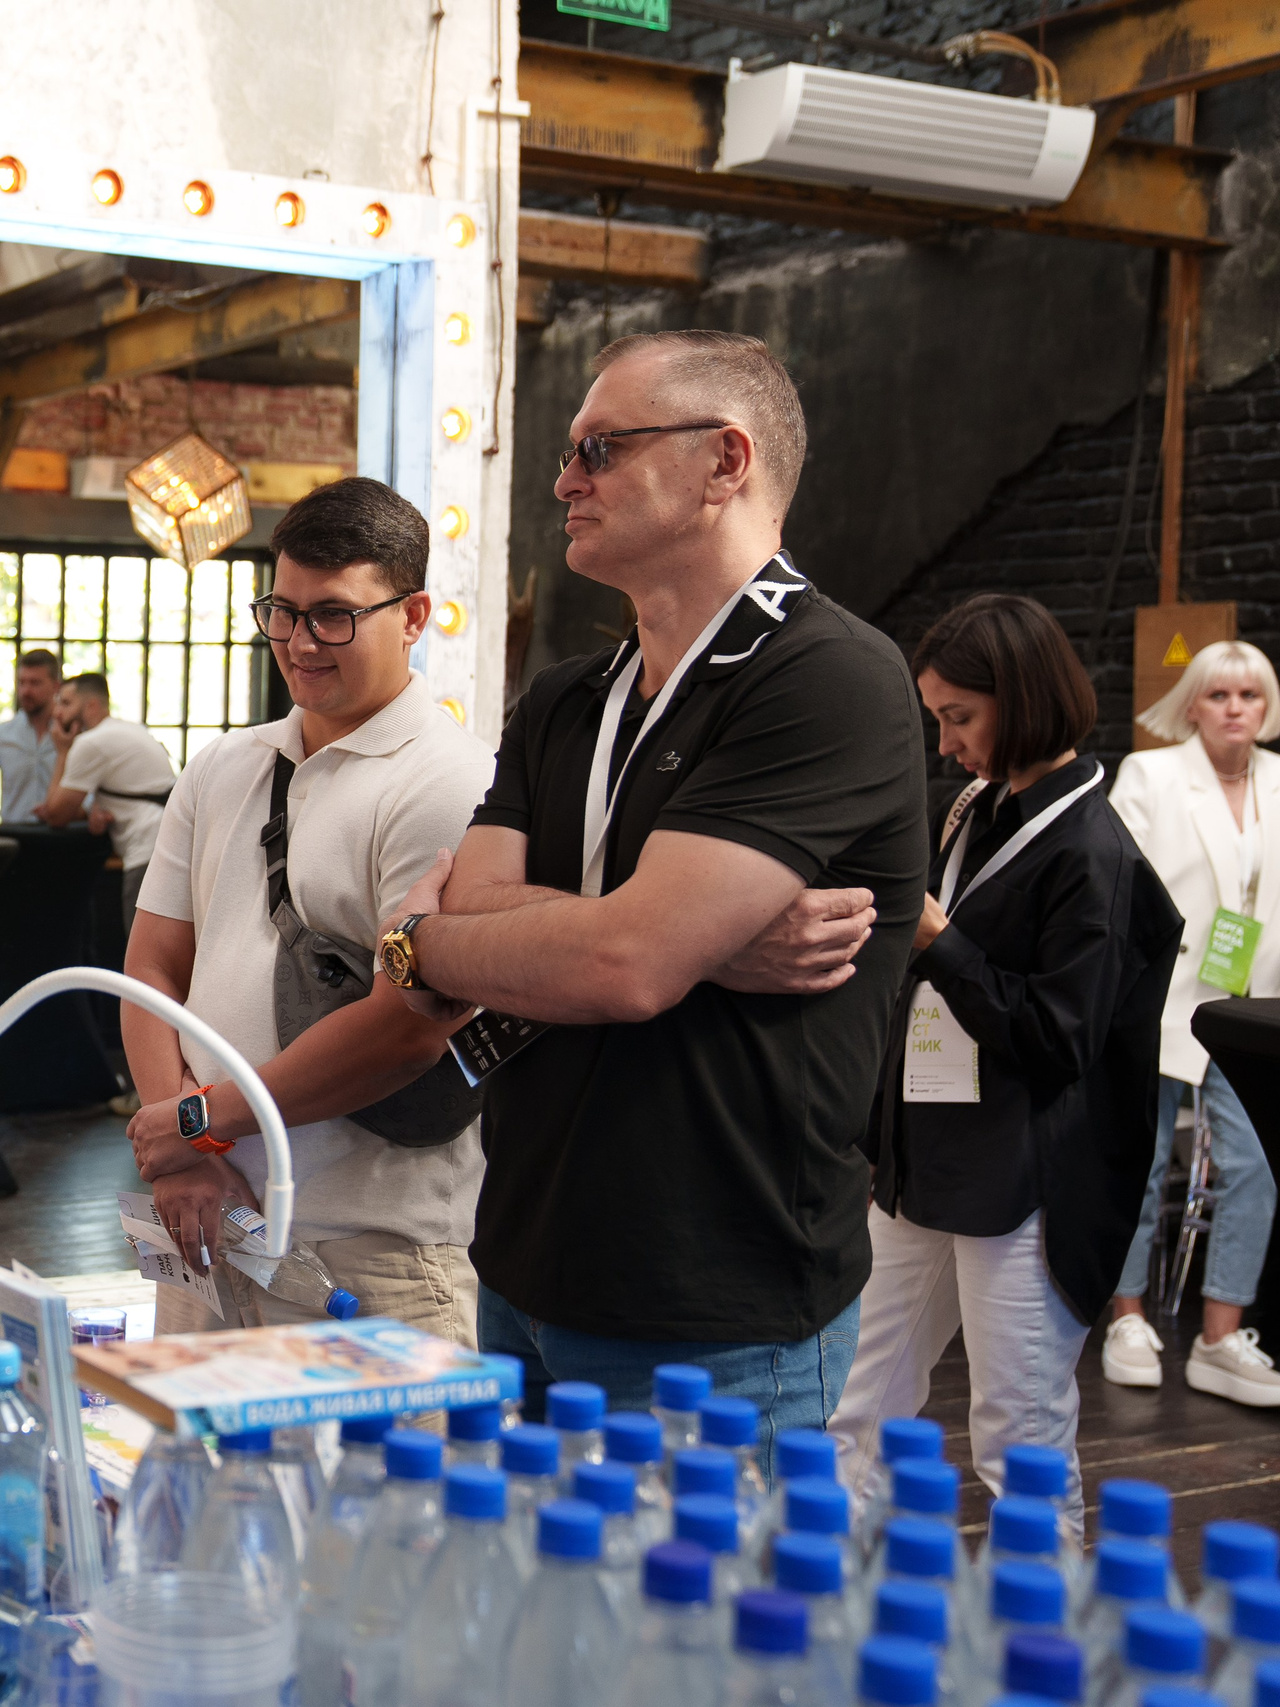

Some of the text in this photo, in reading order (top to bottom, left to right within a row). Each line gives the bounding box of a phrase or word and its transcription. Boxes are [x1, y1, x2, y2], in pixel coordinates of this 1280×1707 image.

[912, 1007, 941, 1020] УЧА
[912, 1023, 930, 1036] СТ
[912, 1040, 942, 1053] НИК
[247, 1380, 499, 1425] ВОДА ЖИВАЯ И МЕРТВАЯ
